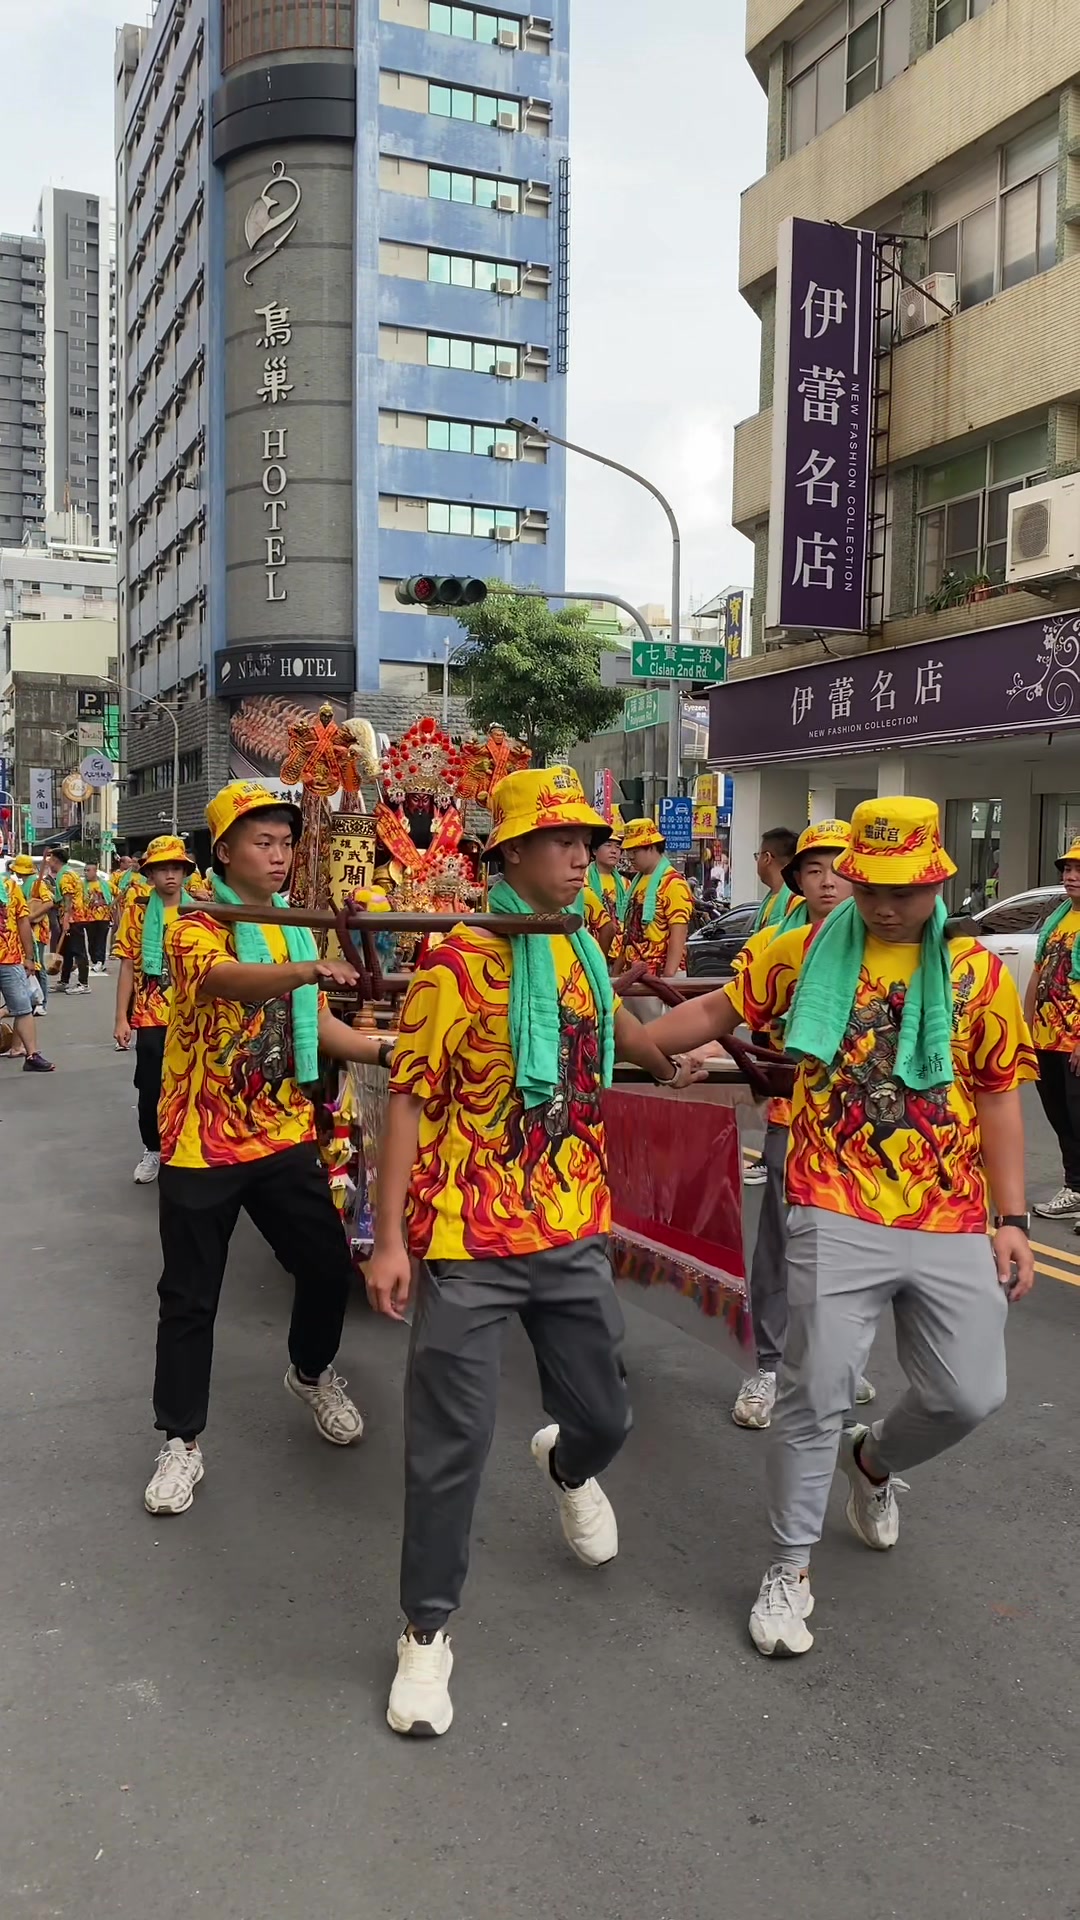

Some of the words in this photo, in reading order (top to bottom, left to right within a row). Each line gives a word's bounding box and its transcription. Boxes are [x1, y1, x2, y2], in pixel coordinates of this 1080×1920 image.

[254, 301, 293, 404] 鳥巢
[850, 383, 860, 416] NEW
[790, 279, 849, 591] 伊蕾名店
[847, 422, 859, 489] FASHION
[260, 427, 288, 603] HOTEL
[844, 496, 856, 592] COLLECTION
[280, 657, 337, 677] HOTEL
[645, 643, 712, 664] 七賢二路
[677, 664, 694, 678] 2nd
[84, 694, 97, 707] P
[790, 659, 944, 726] 伊蕾名店
[808, 729, 825, 739] NEW
[827, 723, 862, 736] FASHION
[864, 715, 919, 731] COLLECTION
[662, 798, 673, 815] P
[864, 824, 900, 842] 靈武宮
